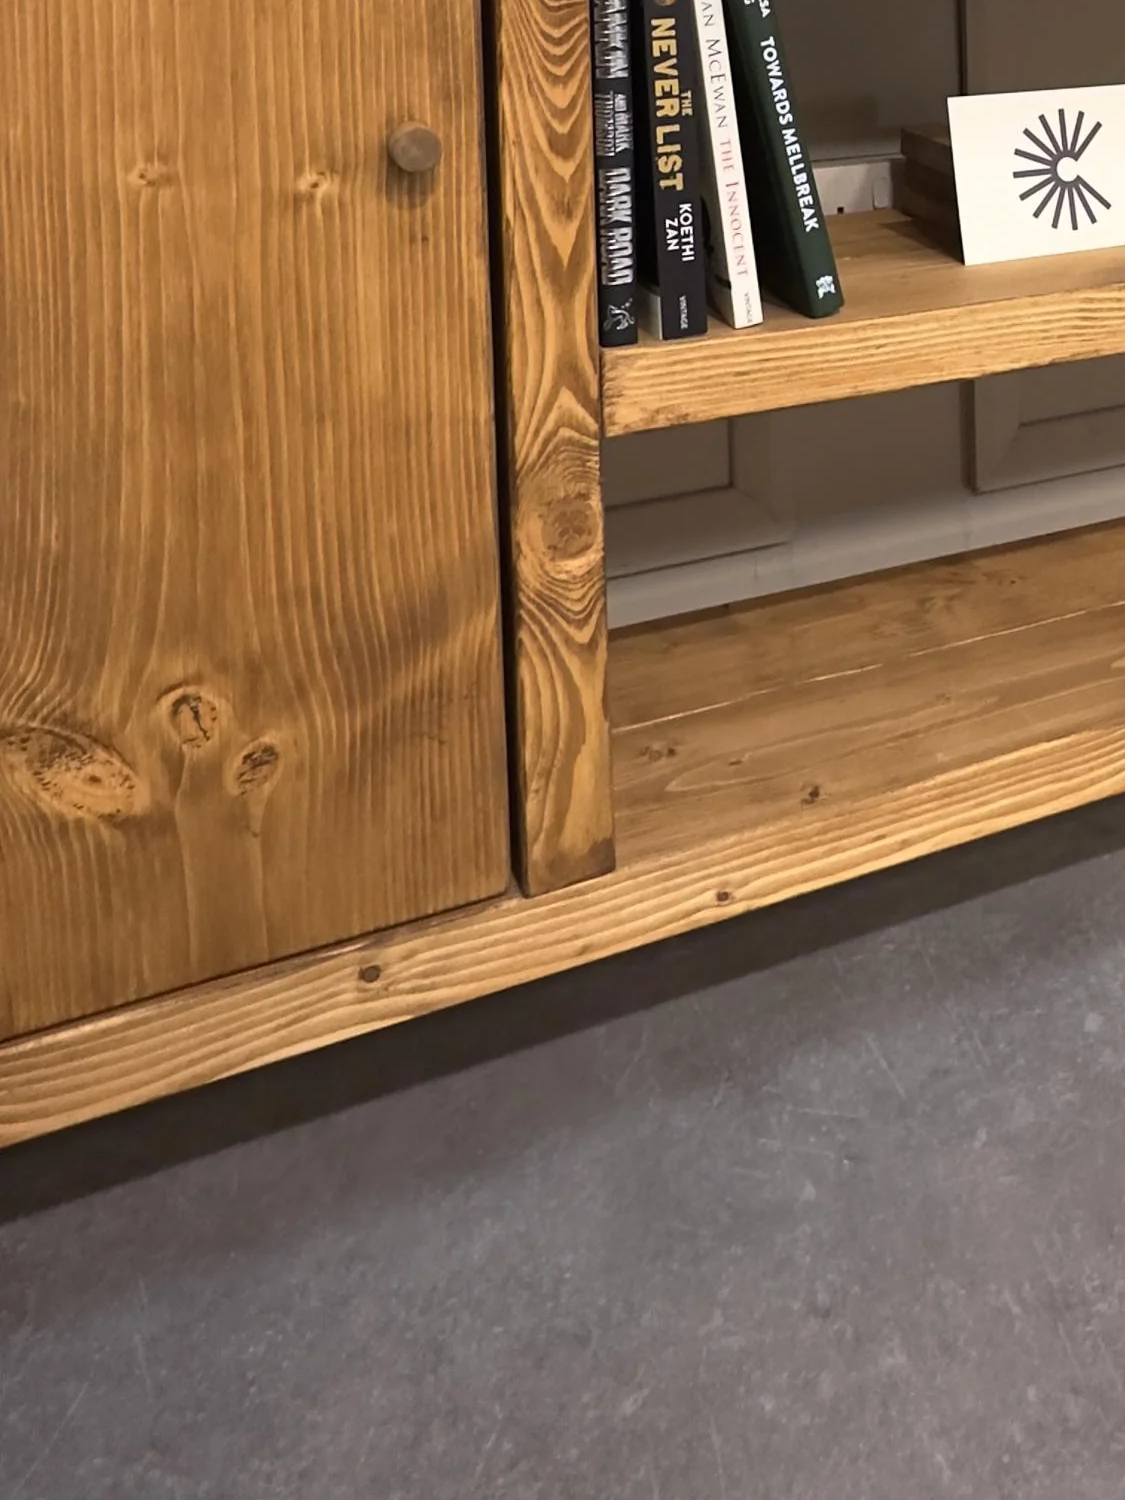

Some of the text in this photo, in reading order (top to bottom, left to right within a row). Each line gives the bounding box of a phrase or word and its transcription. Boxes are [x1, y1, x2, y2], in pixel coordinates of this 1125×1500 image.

[650, 17, 685, 192] NEVER LIST
[680, 90, 693, 117] THE
[614, 111, 634, 153] MARK
[719, 139, 735, 172] THE
[760, 35, 820, 233] TOWARDS MELLBREAK
[599, 167, 634, 286] DARK ROAD
[665, 217, 680, 251] ZAN
[679, 202, 695, 262] KOETHI
[725, 181, 748, 276] INNOCENT
[679, 295, 689, 330] VINTAGE
